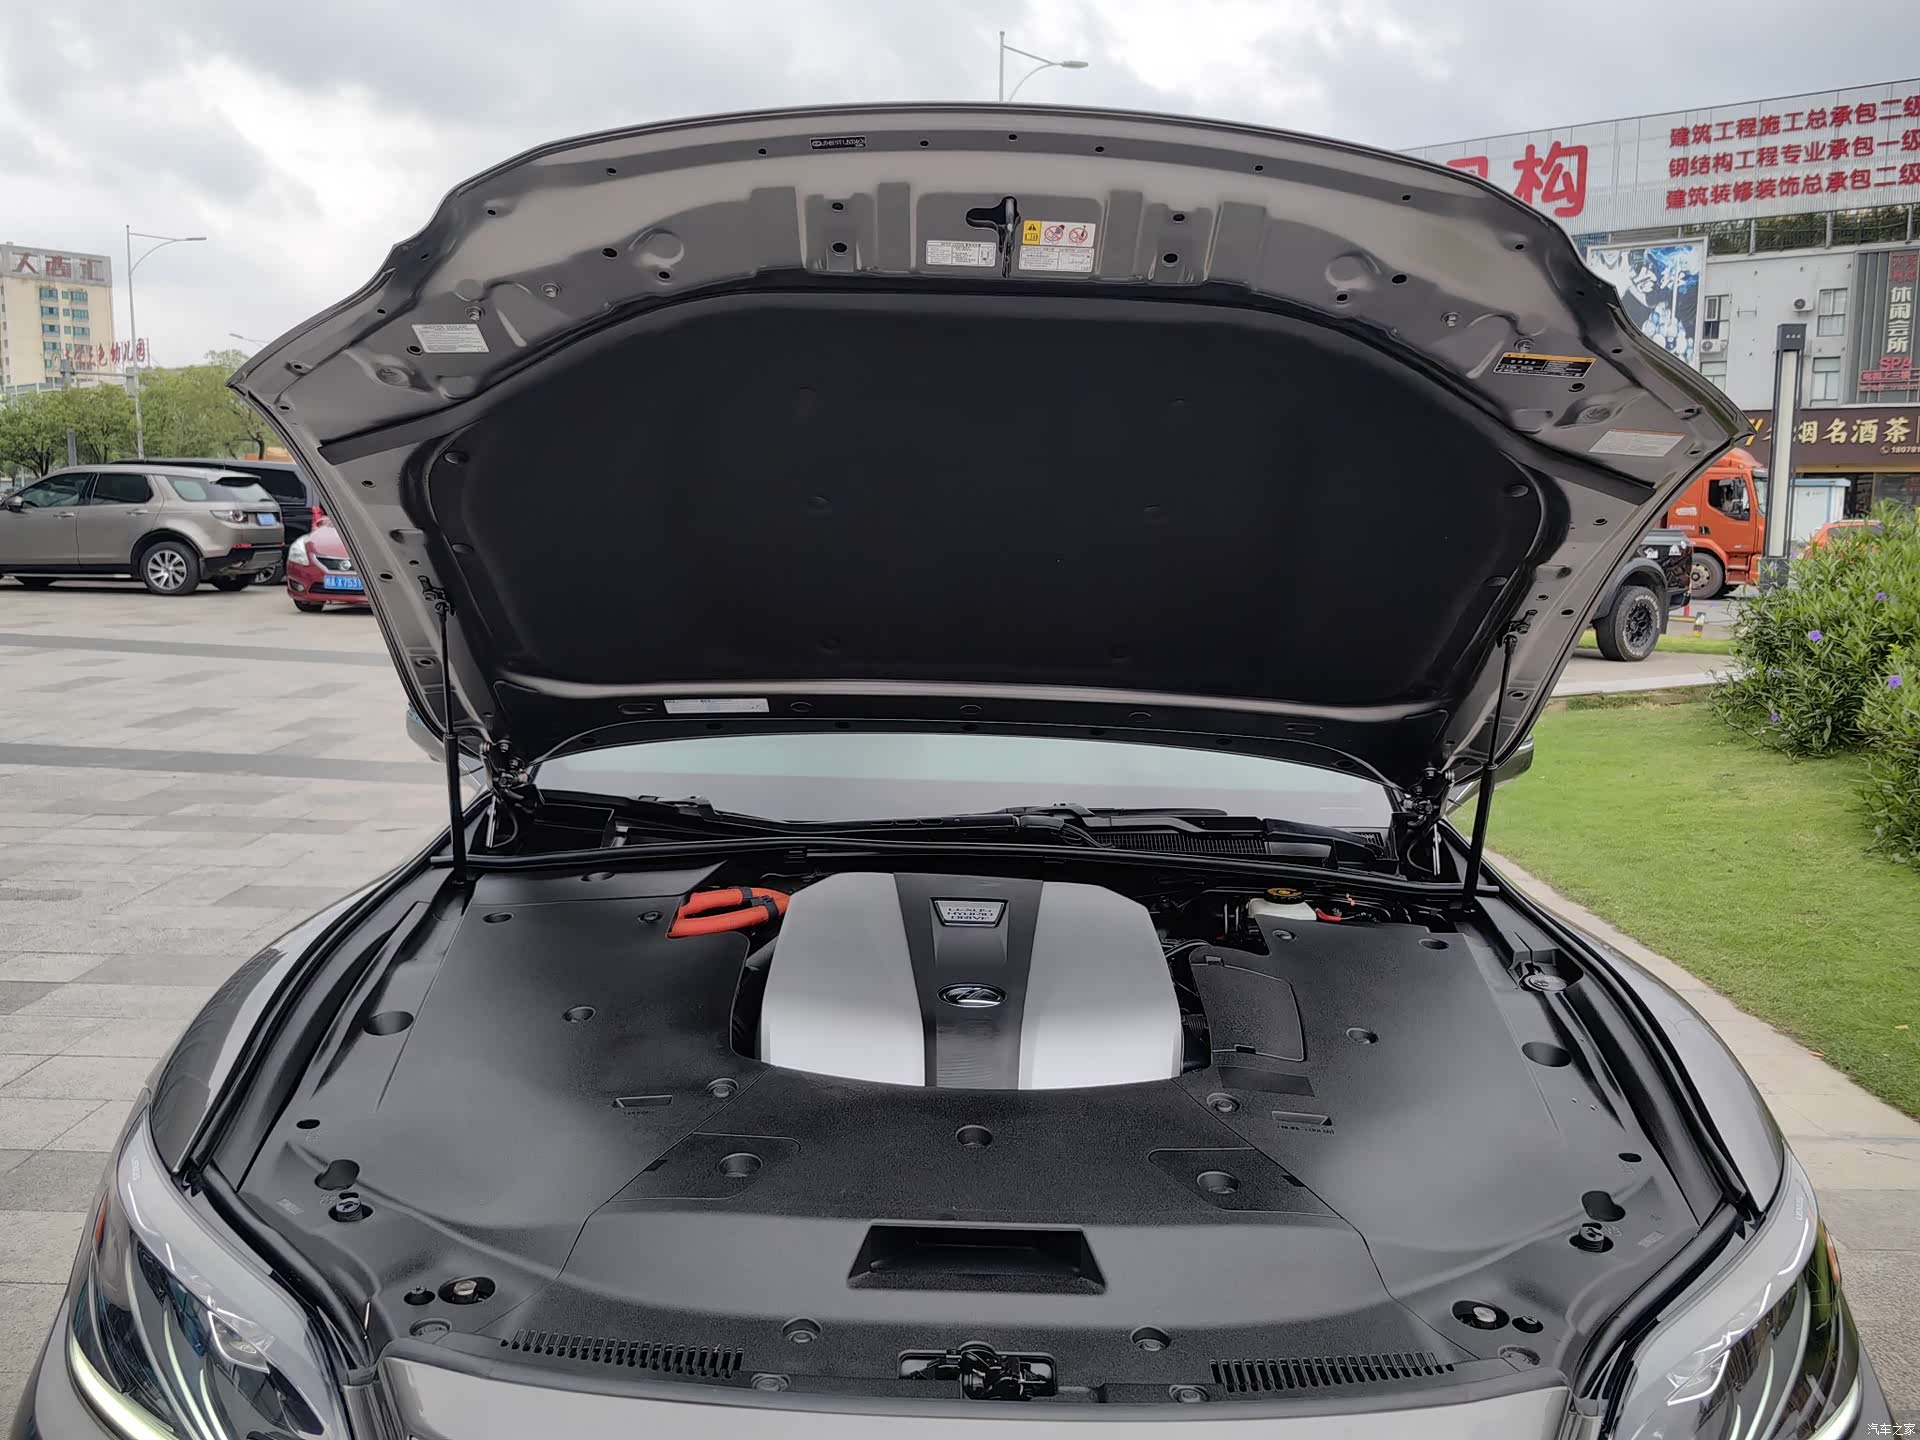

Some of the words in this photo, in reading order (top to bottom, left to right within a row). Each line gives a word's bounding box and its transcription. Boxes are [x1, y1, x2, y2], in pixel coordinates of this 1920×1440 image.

[1669, 95, 1920, 148] 建筑工程施工总承包二级
[1446, 141, 1588, 217] 构
[1668, 128, 1920, 178] 钢结构工程专业承包一级
[1665, 162, 1920, 210] 建筑装修装饰总承包二级
[1886, 286, 1912, 353] 休闲会所
